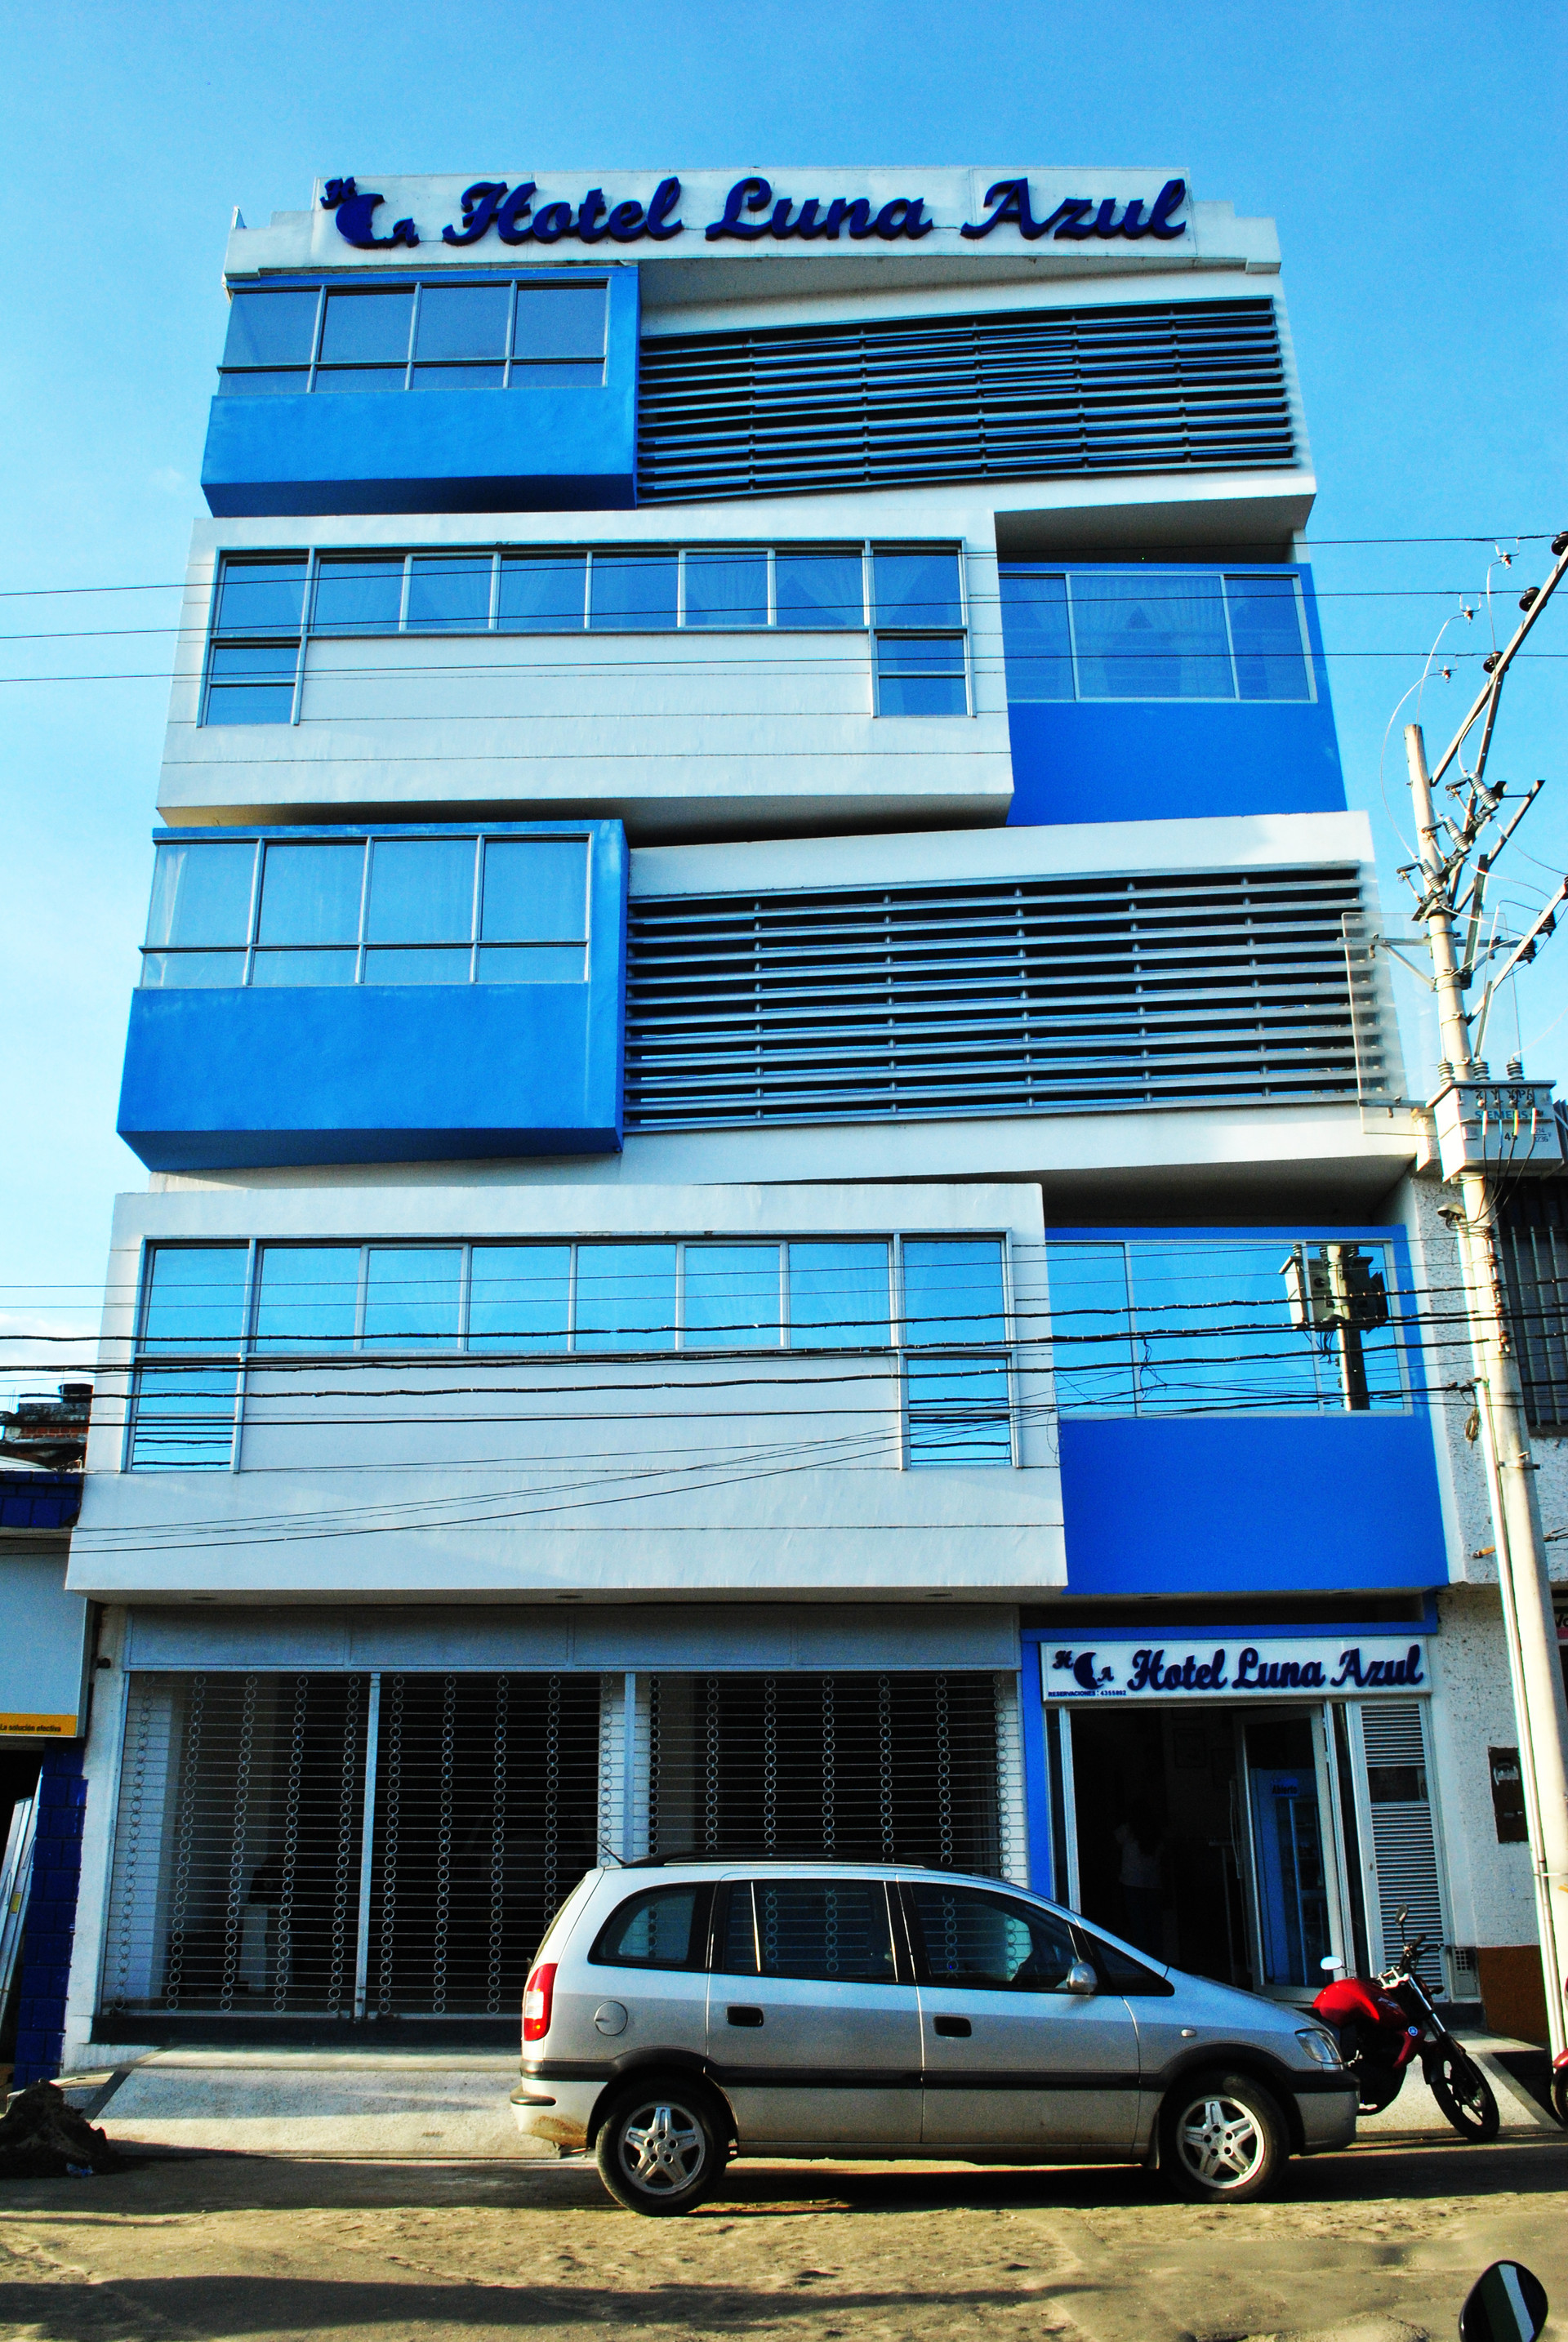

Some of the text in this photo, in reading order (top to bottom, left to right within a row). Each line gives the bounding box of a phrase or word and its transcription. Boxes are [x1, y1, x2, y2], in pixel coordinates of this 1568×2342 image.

[442, 176, 1187, 246] Hotel Luna Azul
[1127, 1644, 1424, 1691] Hotel Luna Azul
[1272, 1785, 1298, 1794] Abierto
